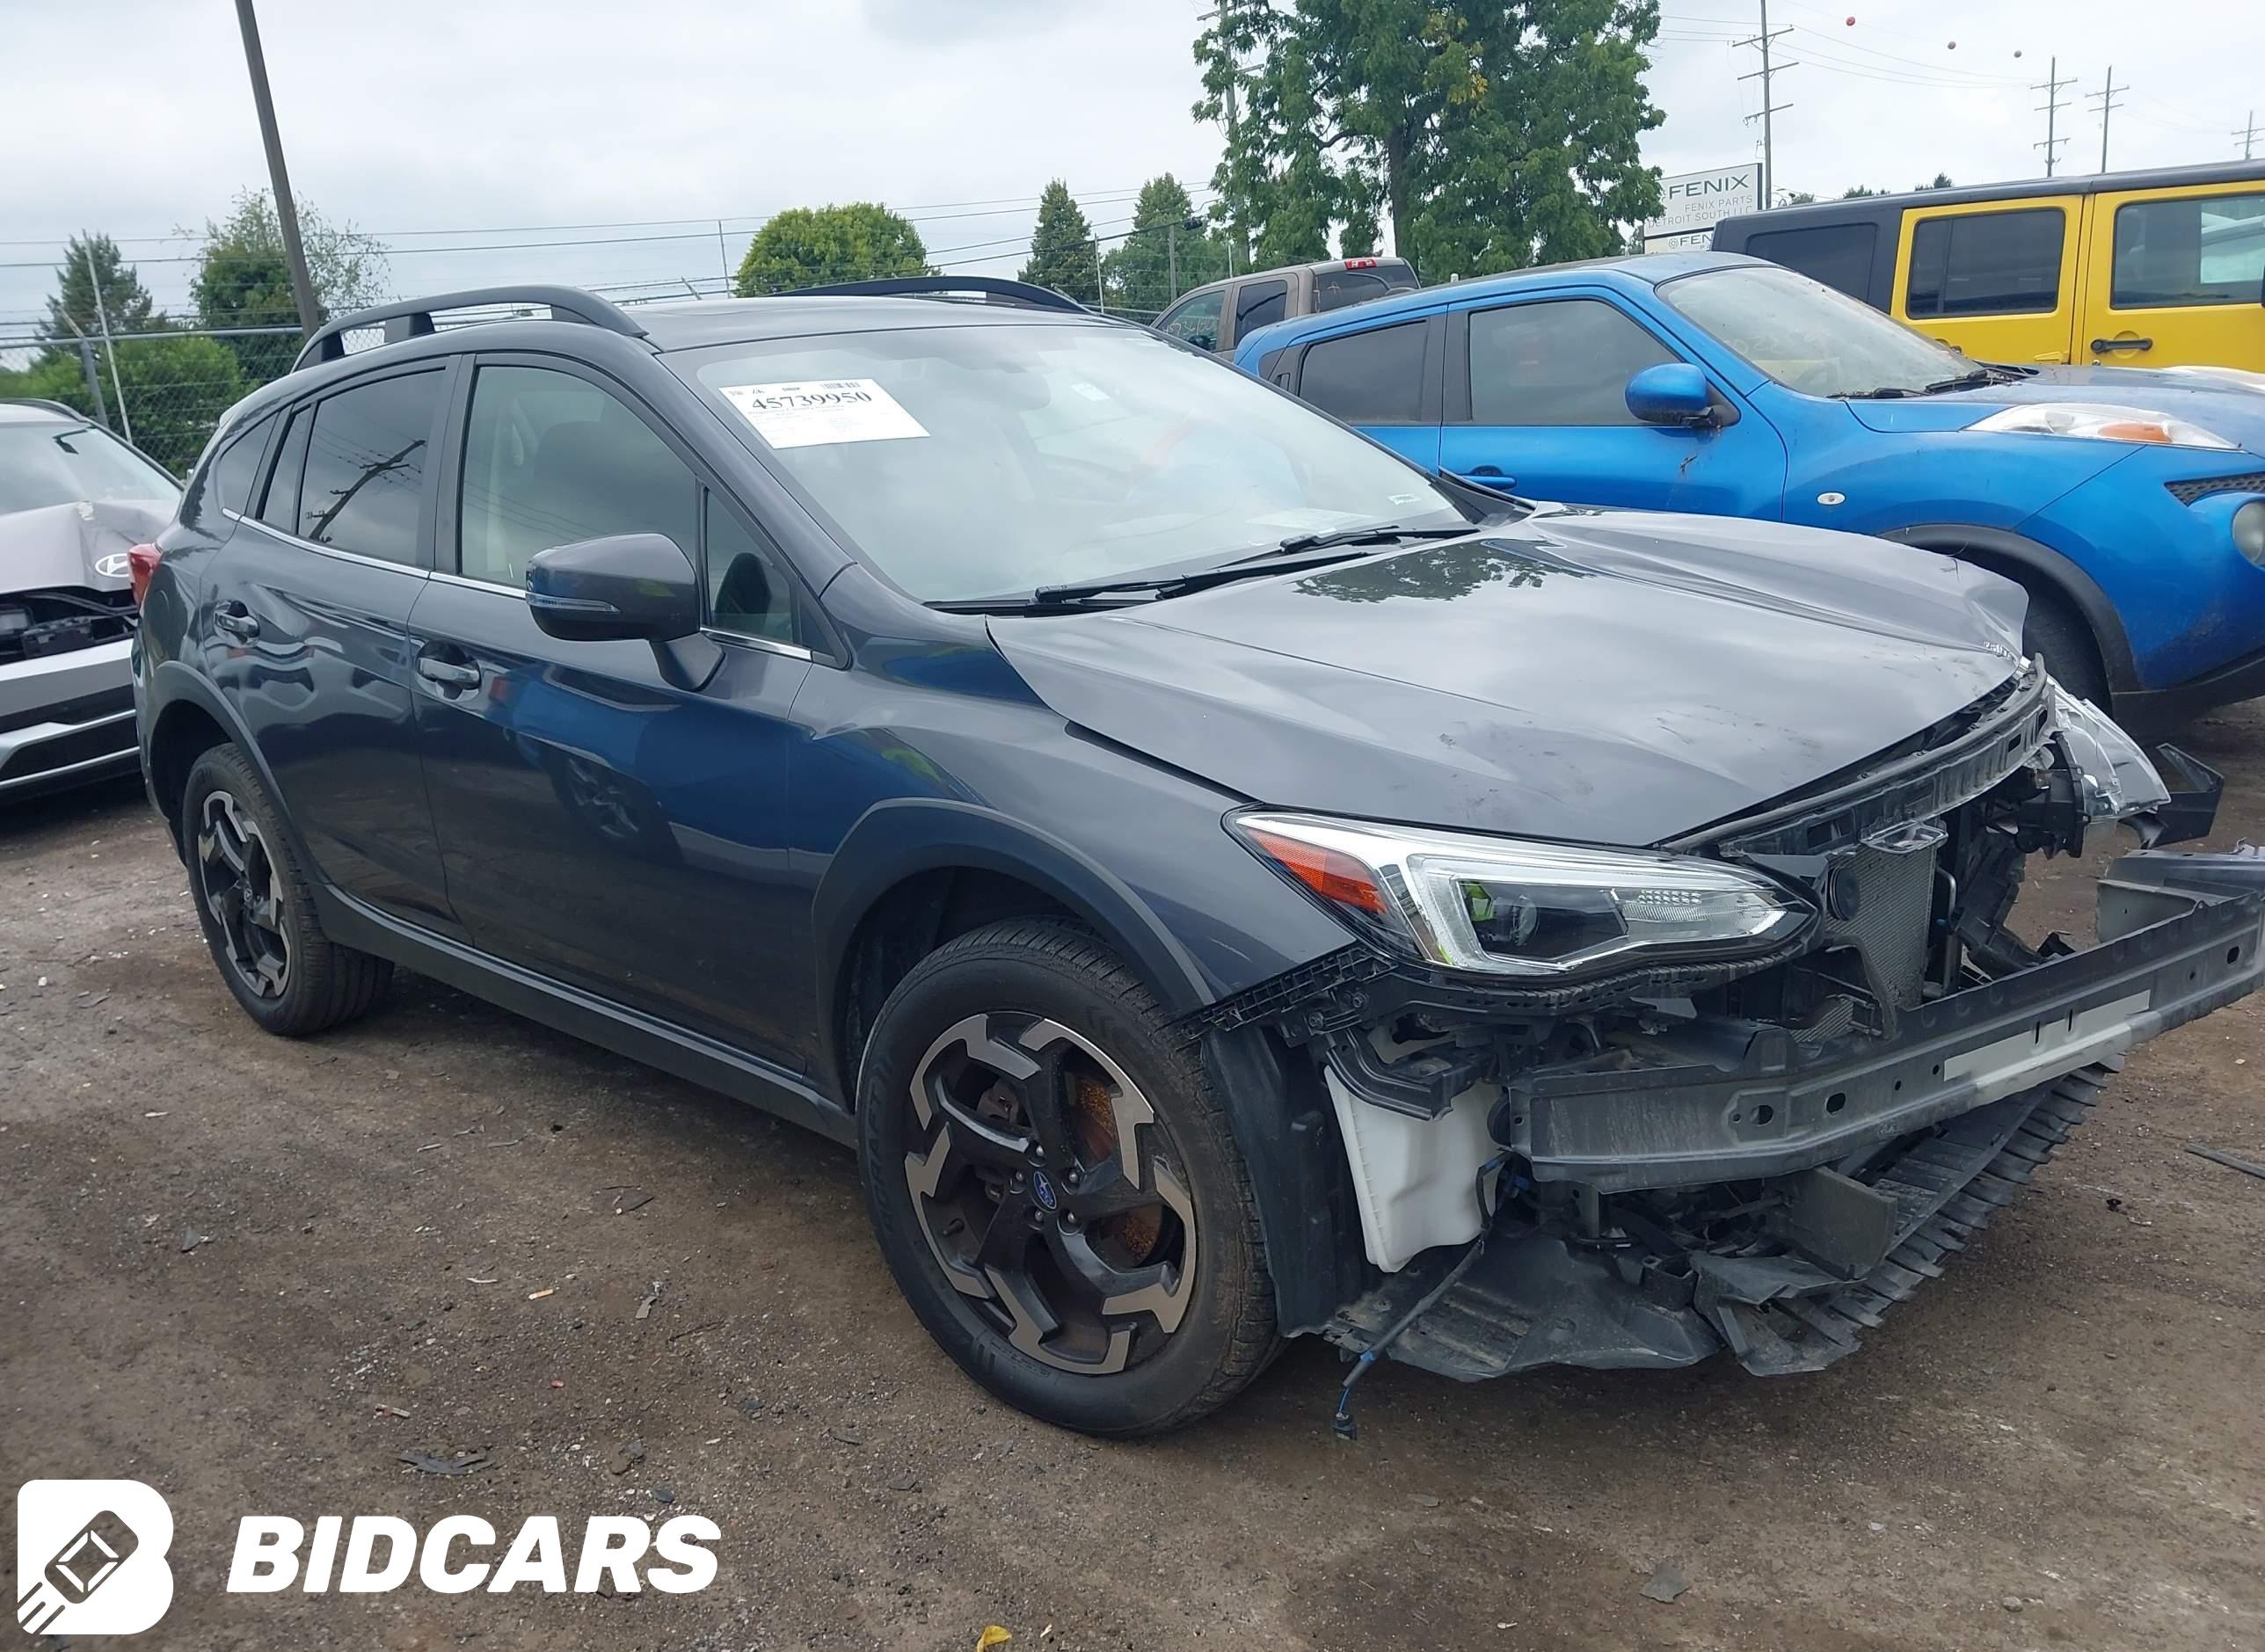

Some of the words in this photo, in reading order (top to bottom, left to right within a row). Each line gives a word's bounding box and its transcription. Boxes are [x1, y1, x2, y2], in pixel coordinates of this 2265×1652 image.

[1669, 174, 1749, 200] FENIX
[1685, 201, 1715, 212] FENIX
[1718, 195, 1752, 206] PARTS
[1648, 215, 1690, 229] DETROIT
[1695, 209, 1730, 222] SOUTH
[1680, 234, 1712, 246] FEN
[752, 390, 872, 410] 45739950
